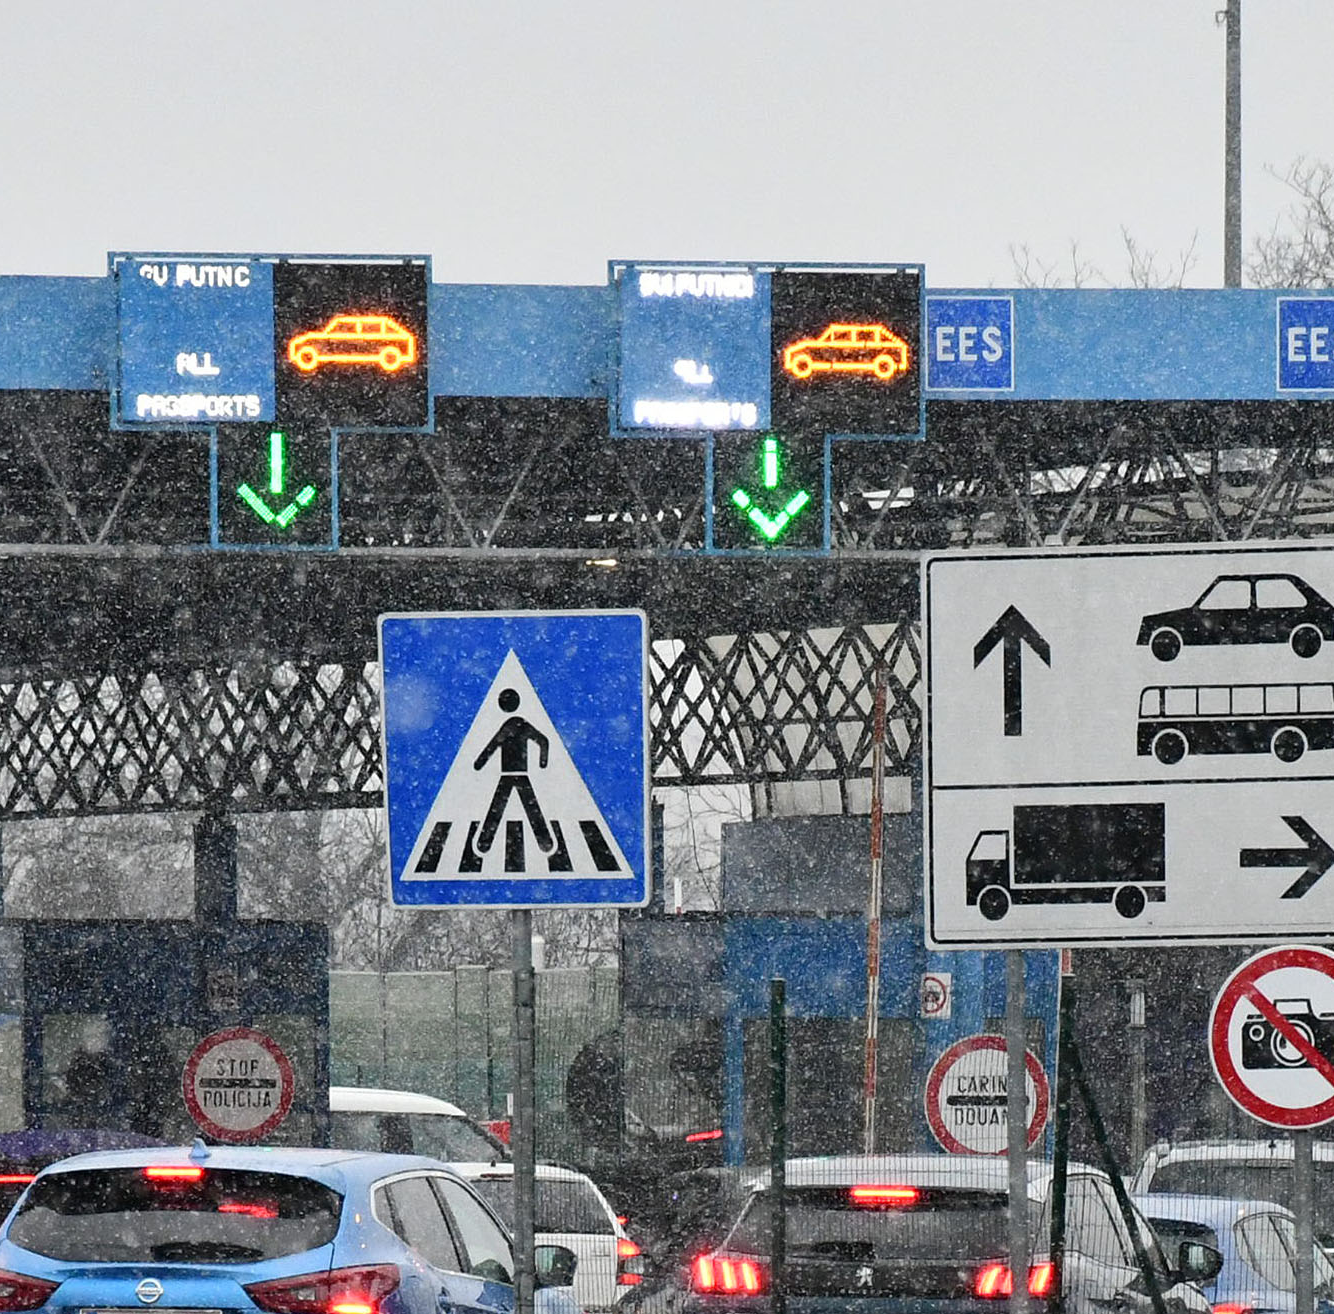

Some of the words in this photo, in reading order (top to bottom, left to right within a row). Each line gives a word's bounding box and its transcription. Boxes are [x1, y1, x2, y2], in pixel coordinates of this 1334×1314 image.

[936, 326, 1002, 362] EES
[216, 1059, 260, 1077] STOP
[957, 1075, 1008, 1094] CARIN
[203, 1090, 272, 1109] POLICIJA
[954, 1107, 1008, 1127] DOUA
